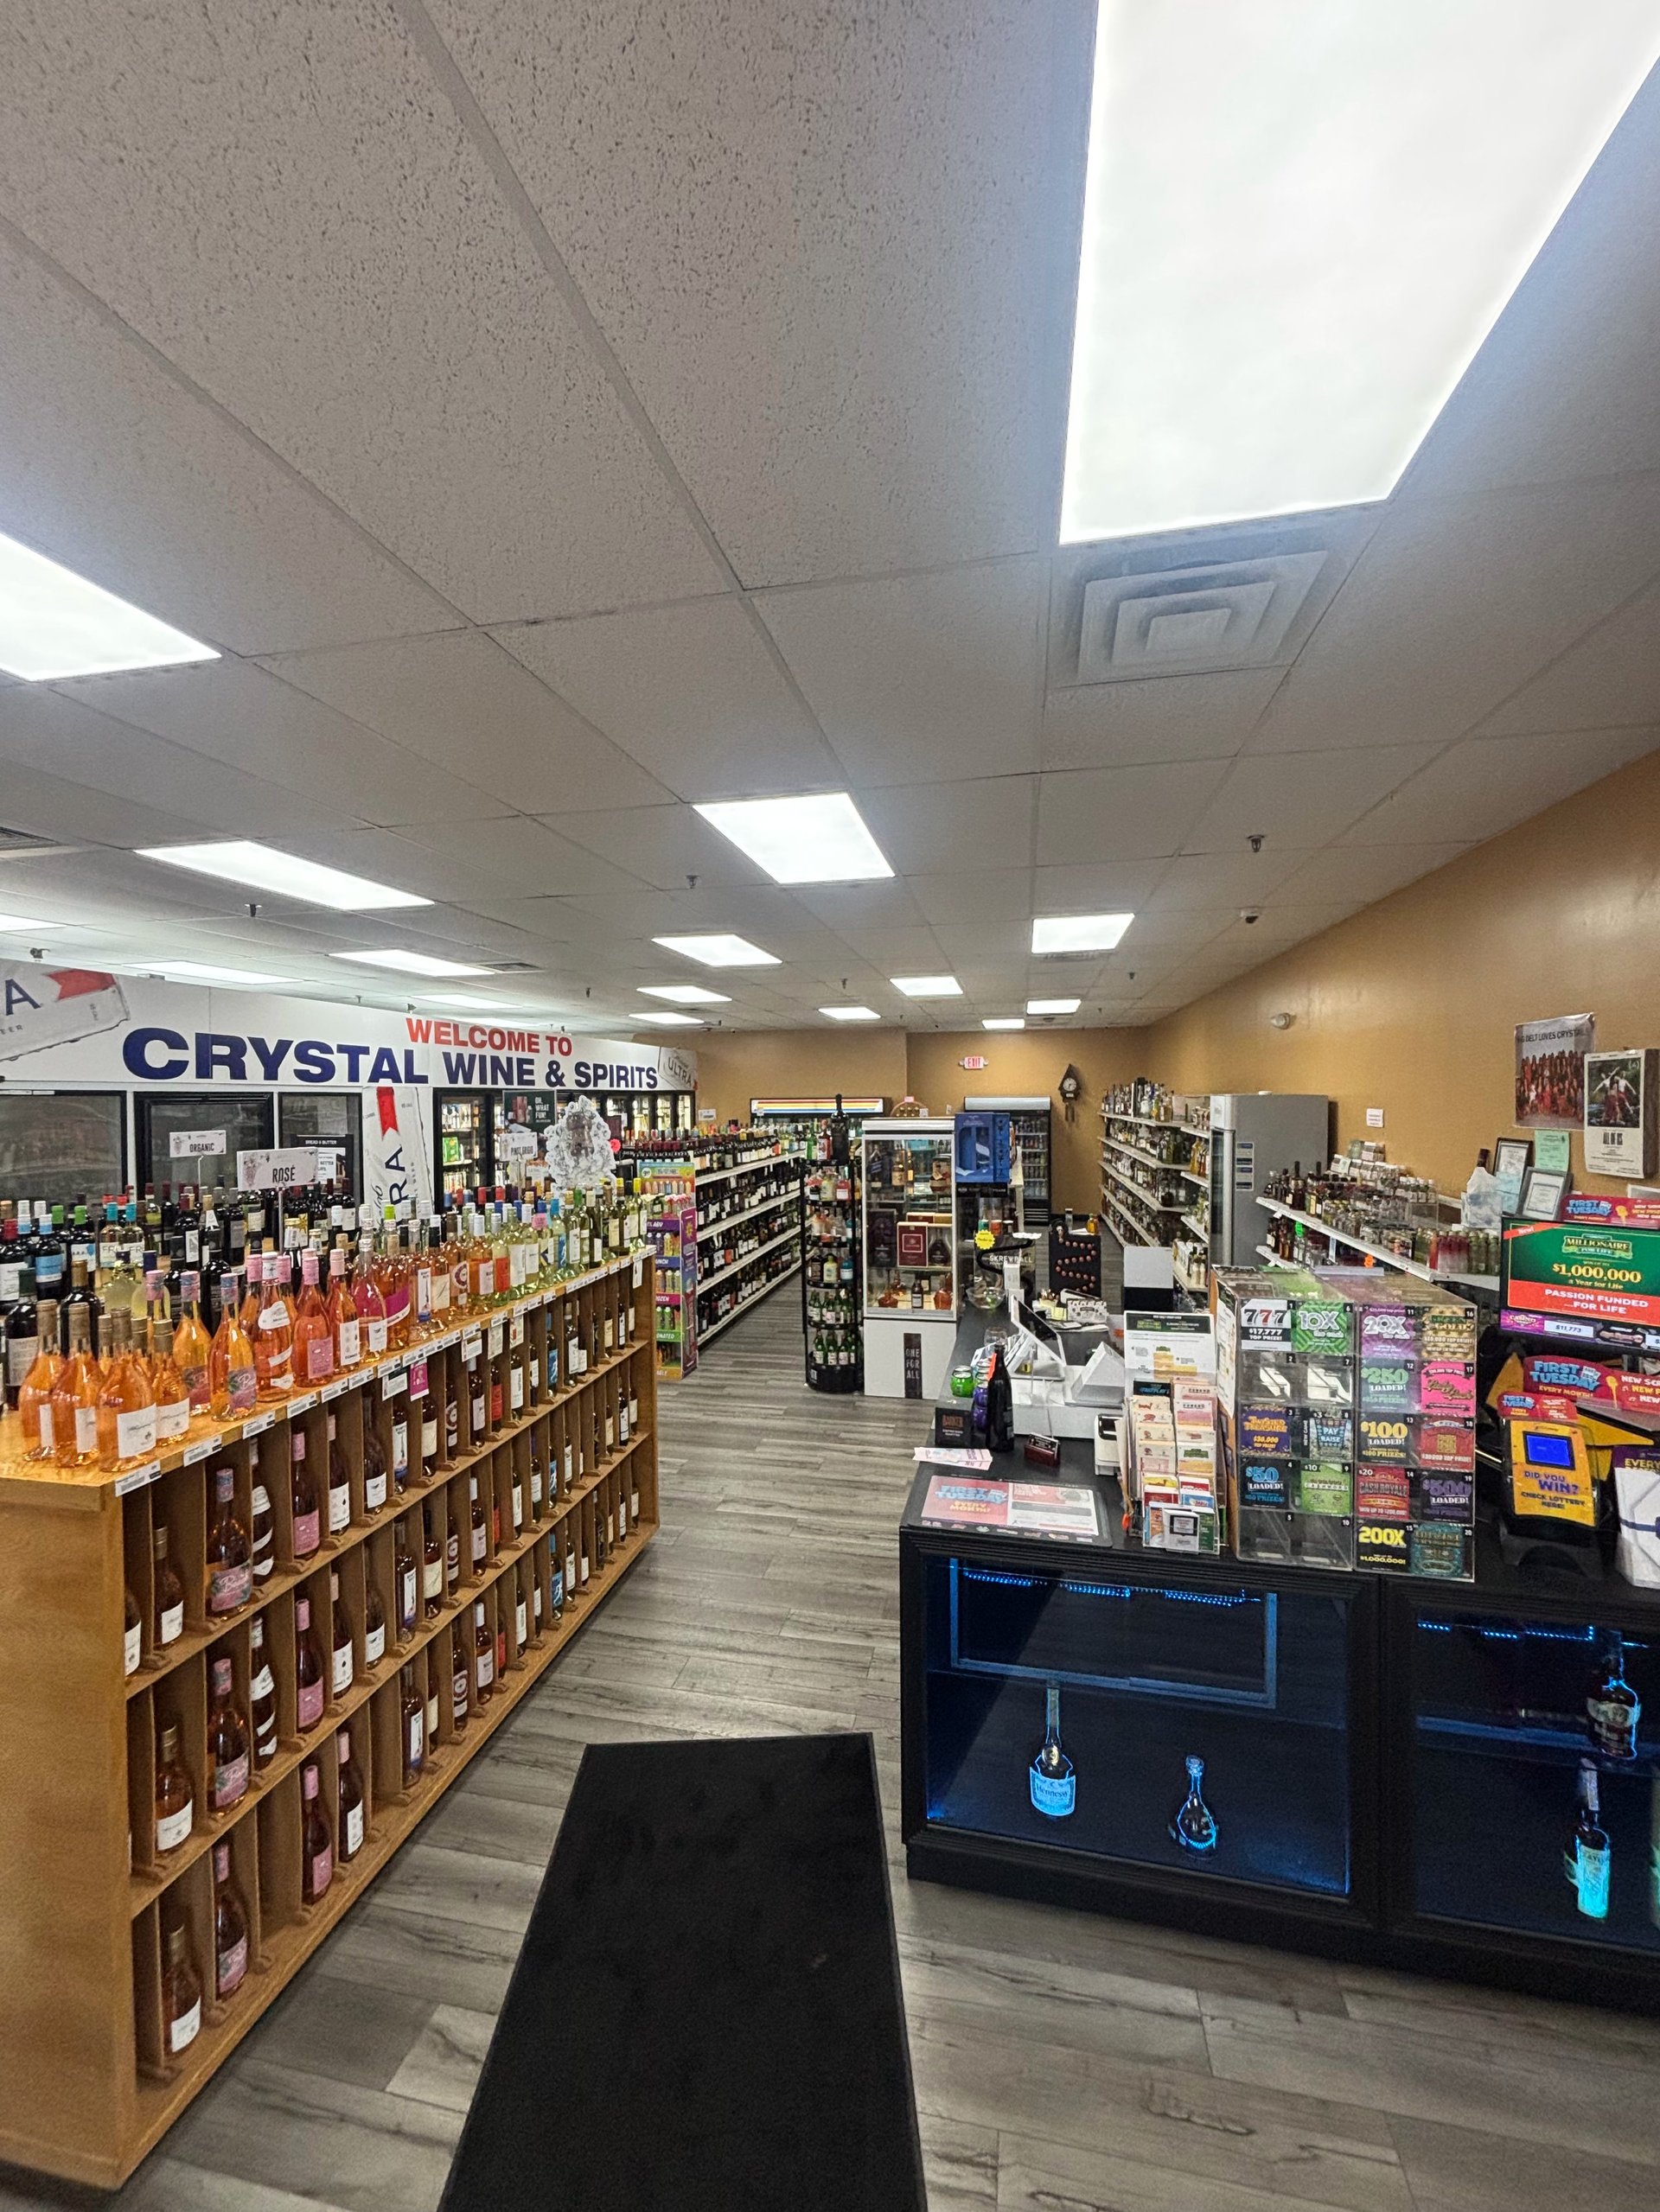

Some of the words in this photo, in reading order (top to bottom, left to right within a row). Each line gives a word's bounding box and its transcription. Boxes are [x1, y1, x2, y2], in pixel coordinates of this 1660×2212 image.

[405, 1017, 540, 1054] WELCOME
[546, 1036, 572, 1056] TO
[1538, 1030, 1556, 1042] LOVES
[122, 1027, 429, 1084] CRYSTAL
[442, 1051, 536, 1087] WINE
[545, 1060, 566, 1087] &
[573, 1061, 658, 1089] SPIRITS
[967, 1057, 981, 1068] EXIT
[667, 1056, 692, 1087] ULTRA
[189, 1142, 214, 1152] ORGANIC
[271, 1166, 296, 1183] ROSÉ
[1517, 1227, 1535, 1235] New!
[1566, 1238, 1630, 1251] MILLIONAIRE
[1552, 1263, 1642, 1284] $1,000,000
[1544, 1288, 1595, 1302] PASSION
[1597, 1294, 1649, 1308] FUNDED
[1599, 1304, 1627, 1314] LIFE
[1244, 1309, 1288, 1326] 777
[1299, 1310, 1340, 1330] 10X
[1363, 1314, 1408, 1335] 20X
[1248, 1328, 1283, 1336] $17,777
[905, 1348, 920, 1358] ONE
[906, 1360, 920, 1368] FOR
[1533, 1361, 1580, 1374] FIRST
[907, 1370, 920, 1380] ALL
[1361, 1367, 1409, 1385] $250
[1529, 1371, 1600, 1392] TUESDAY
[1621, 1375, 1643, 1384] NEW
[1538, 1385, 1562, 1393] EVERY
[1562, 1388, 1594, 1399] MONTH!
[1631, 1385, 1654, 1394] NEW
[1639, 1395, 1660, 1404] NEW
[1360, 1421, 1408, 1438] $100
[1624, 1457, 1660, 1469] EVERY
[1246, 1466, 1280, 1483] $50
[1523, 1471, 1542, 1481] DID
[1543, 1473, 1566, 1482] YOU
[940, 1485, 988, 1495] FIRST
[1248, 1482, 1283, 1490] LOADED!
[1359, 1482, 1382, 1495] CASH
[1382, 1483, 1408, 1497] ROYALE
[1537, 1478, 1580, 1495] WIN?
[935, 1491, 1007, 1505] TUESDAY
[1430, 1496, 1469, 1505] LOADED!
[1520, 1491, 1547, 1501] CHECK
[1548, 1495, 1586, 1506] LOTTERY
[1541, 1501, 1566, 1510] HERE!
[1358, 1526, 1408, 1546] 200X
[1359, 1555, 1407, 1565] $1,000,000!
